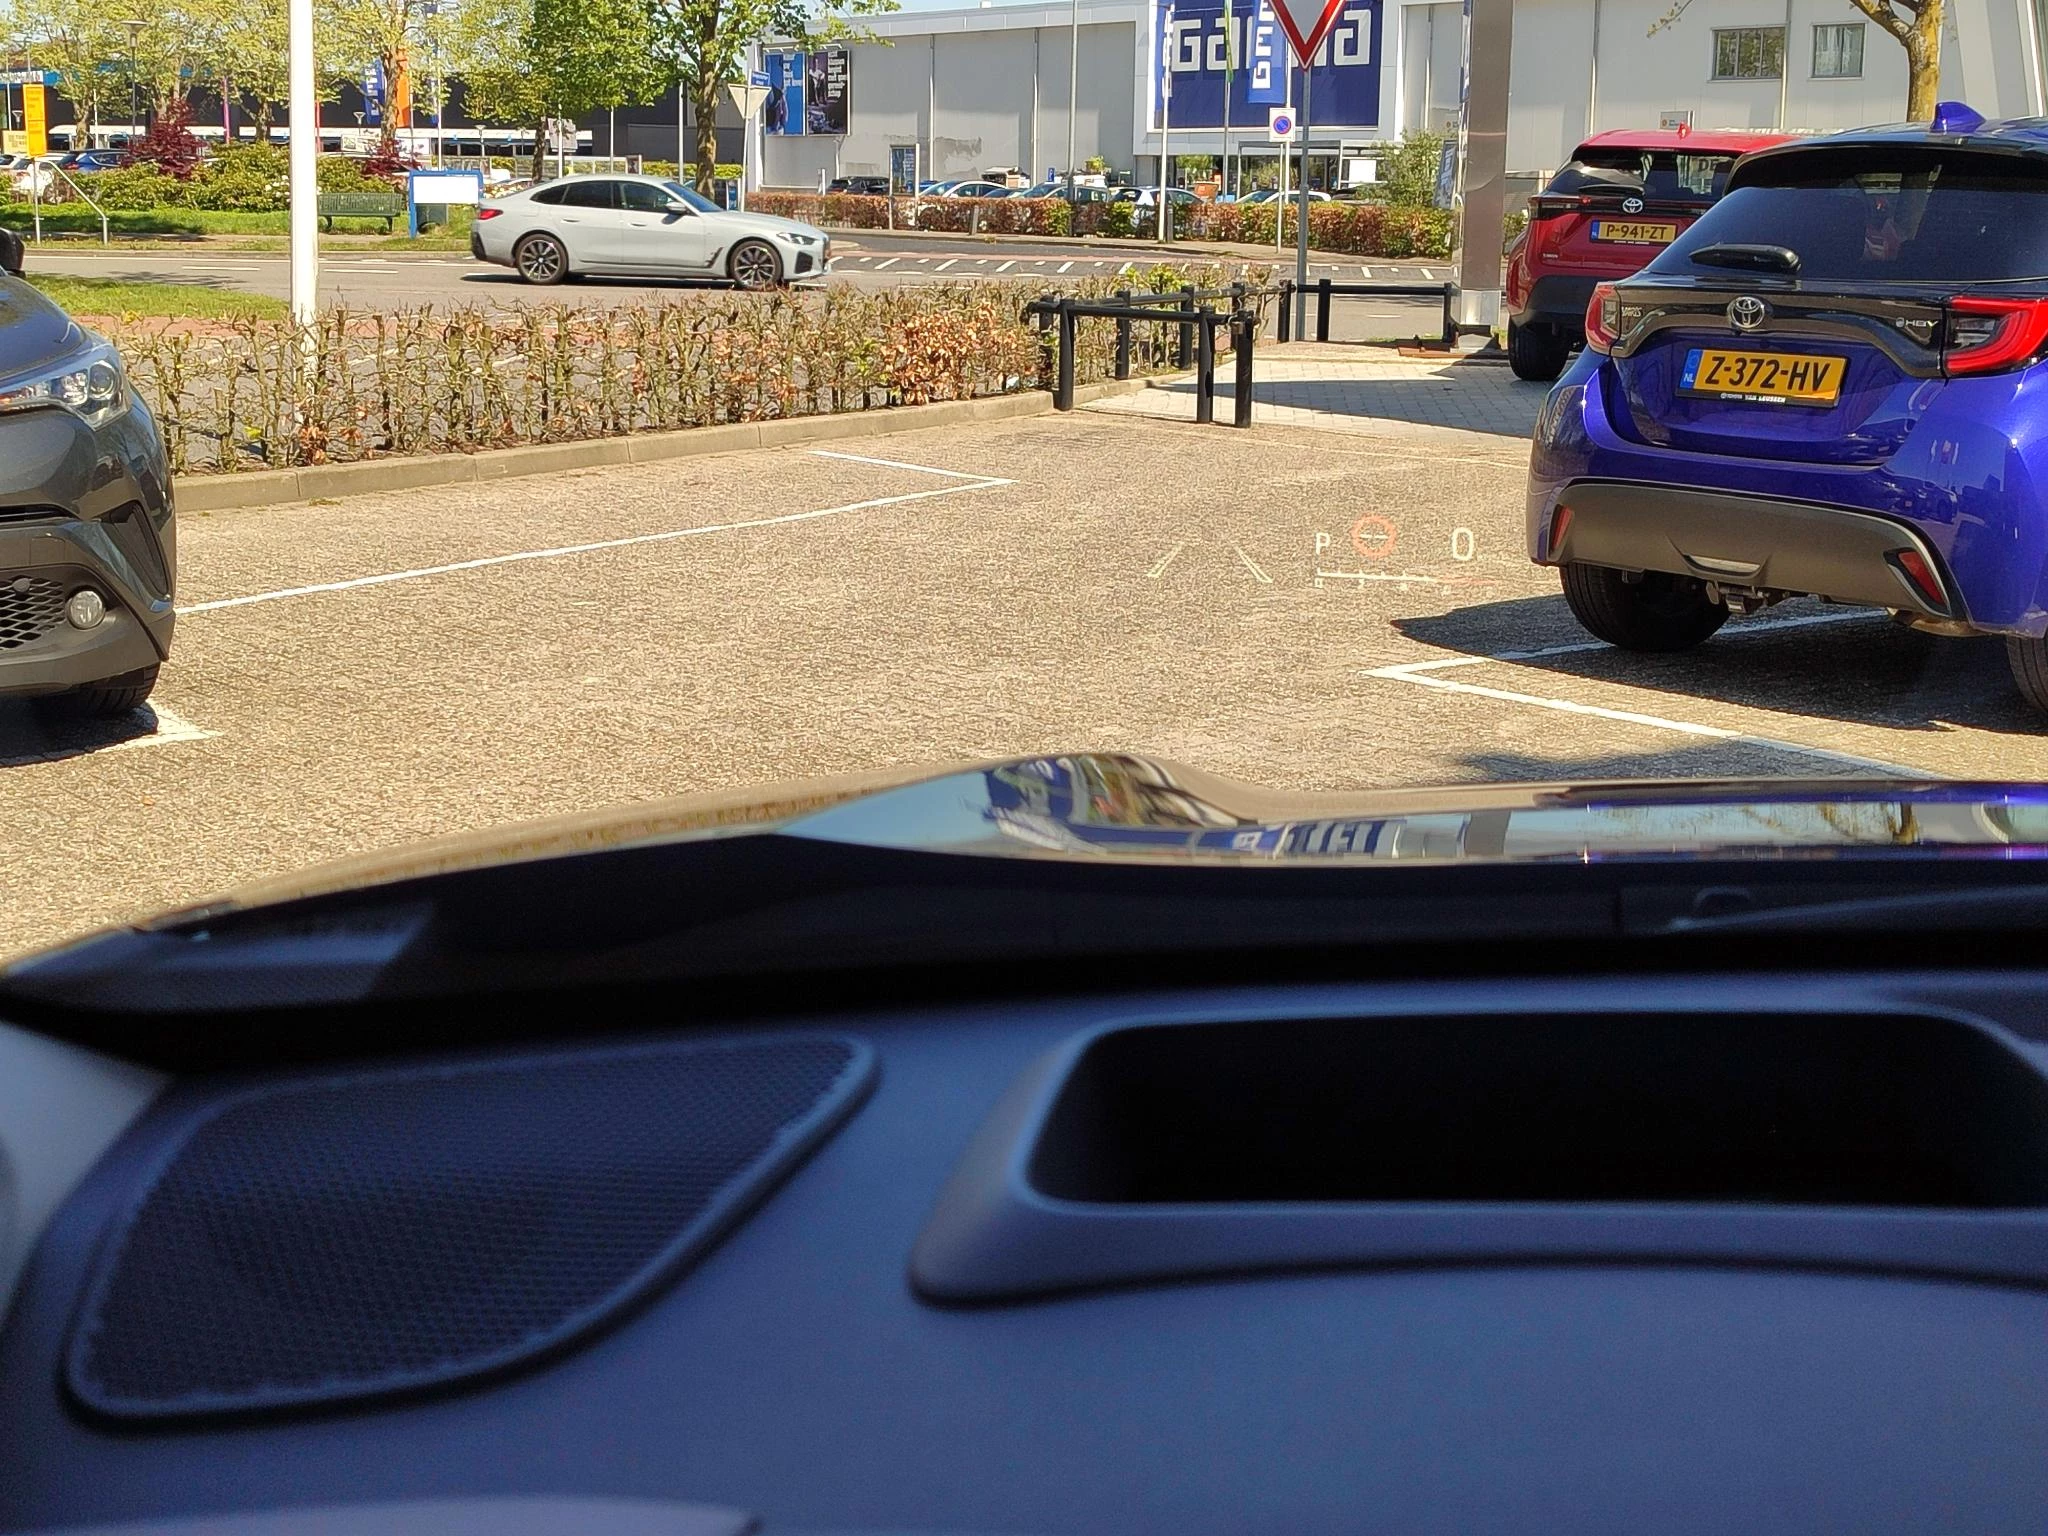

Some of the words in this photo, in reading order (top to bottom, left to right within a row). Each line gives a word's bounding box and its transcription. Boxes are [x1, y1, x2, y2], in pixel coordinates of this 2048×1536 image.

[1606, 223, 1667, 240] P-941-ZT
[1683, 373, 1694, 382] NL
[1705, 356, 1830, 391] Z-372-HV
[1315, 532, 1331, 555] P
